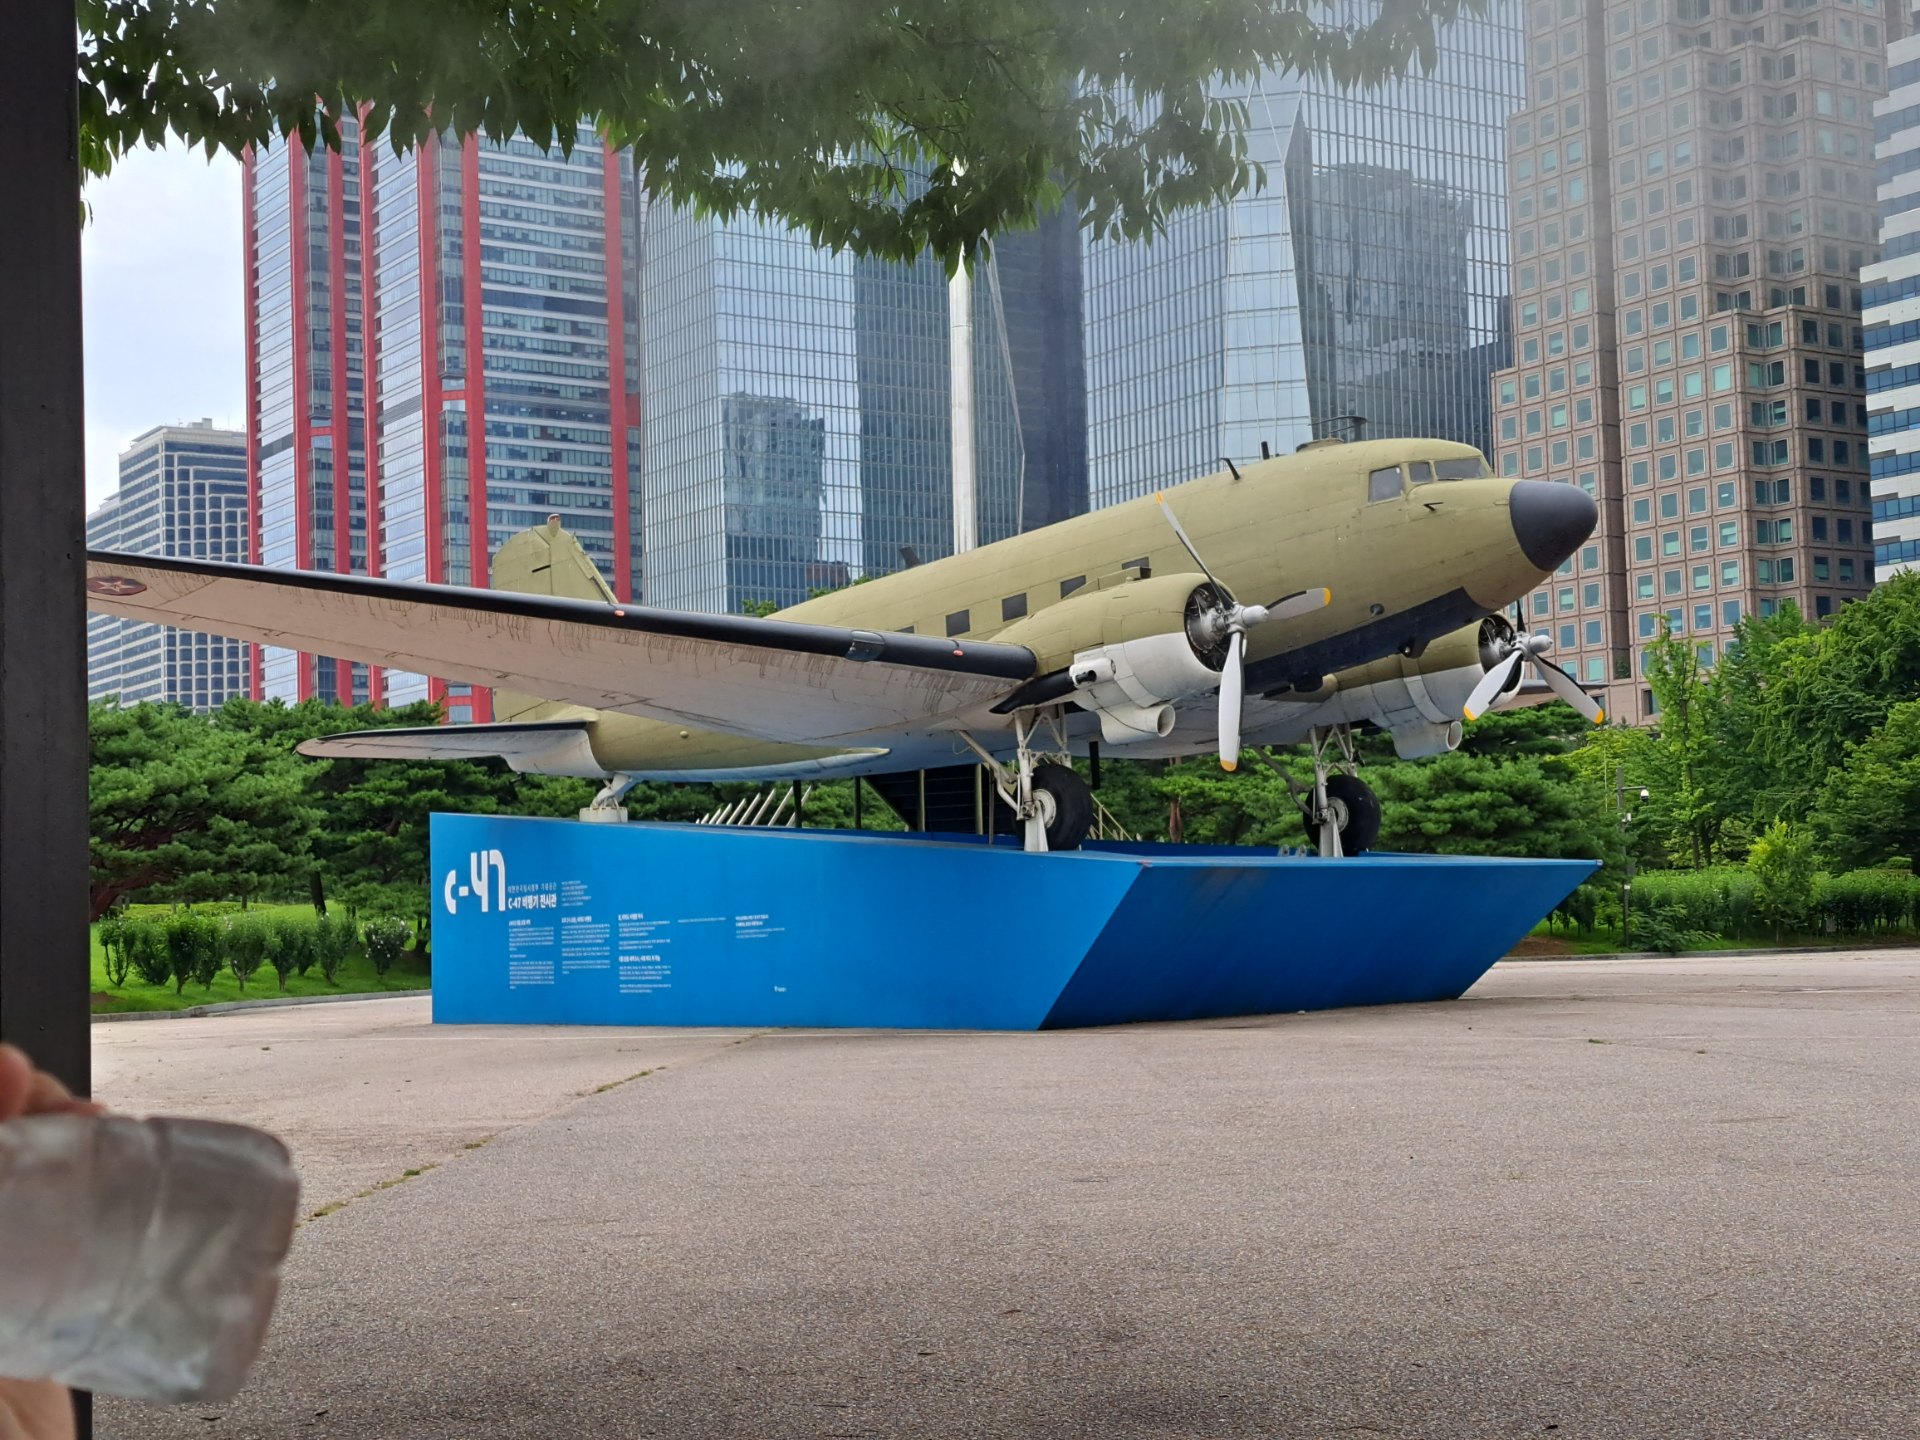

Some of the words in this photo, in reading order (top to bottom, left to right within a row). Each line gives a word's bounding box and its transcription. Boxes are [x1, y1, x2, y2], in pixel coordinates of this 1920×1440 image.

[444, 849, 506, 915] C-47
[522, 894, 539, 909] 비행기
[540, 893, 557, 908] 전시관
